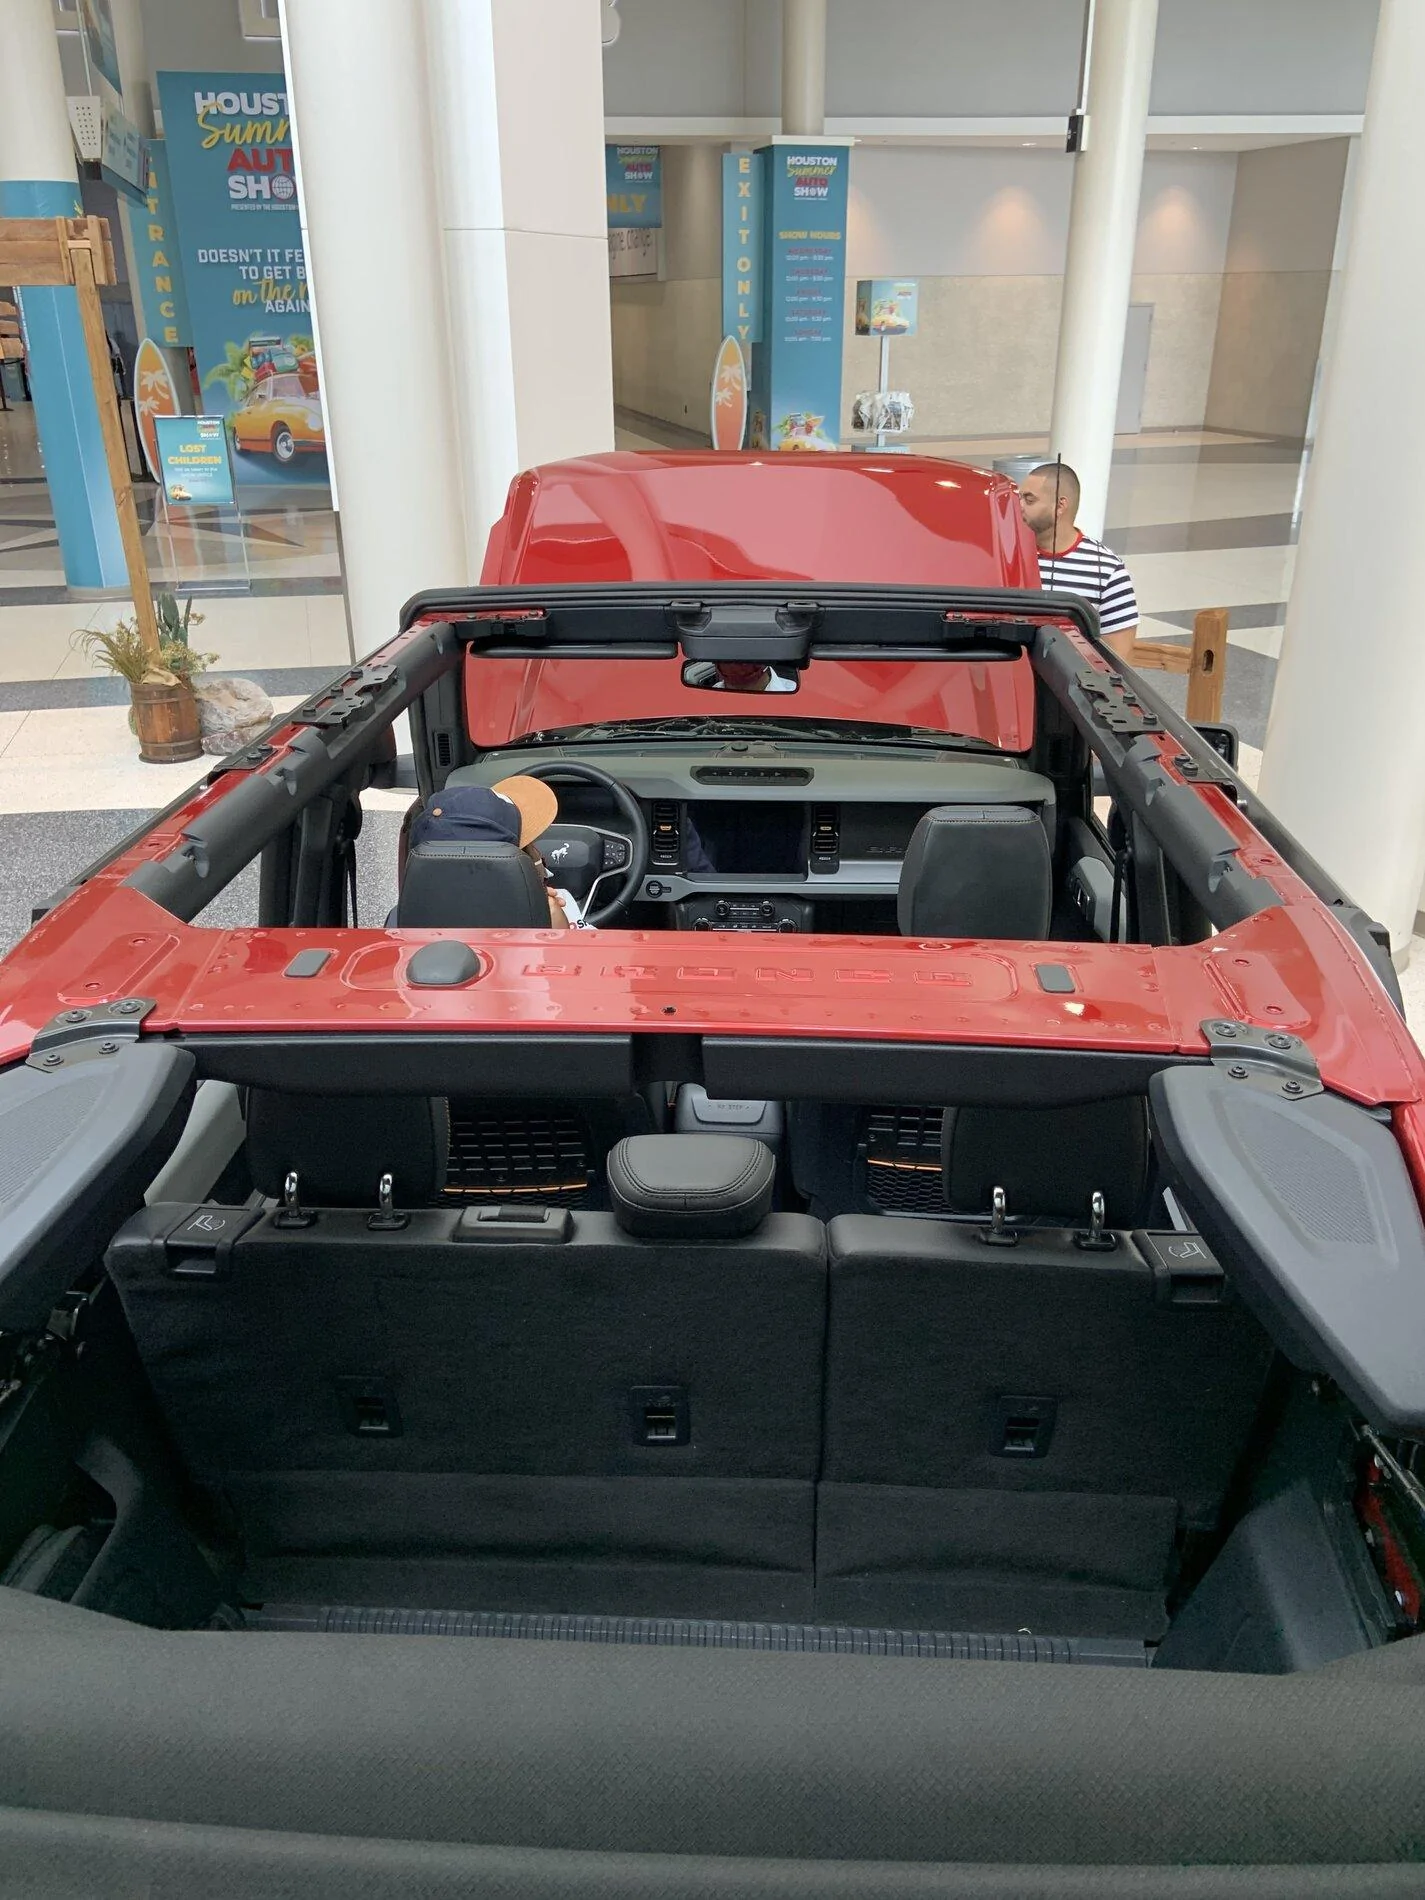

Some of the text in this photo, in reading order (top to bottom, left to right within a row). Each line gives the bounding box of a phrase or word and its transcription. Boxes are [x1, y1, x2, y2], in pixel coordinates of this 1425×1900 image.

[194, 91, 290, 116] HOUST
[197, 102, 290, 149] Sum
[617, 146, 658, 155] HOUSTON
[227, 147, 294, 172] AUT
[787, 156, 837, 166] HOUSTON
[624, 171, 653, 180] SHOW
[796, 177, 827, 187] AUTO
[228, 174, 297, 200] SHO
[794, 186, 828, 197] SHOW
[607, 193, 647, 213] NLY
[779, 231, 841, 240] SHOW HOURS
[147, 147, 179, 343] NTRANCE
[736, 158, 751, 340] EXIT ONLY
[198, 249, 304, 263] DOESN'T IT FE
[239, 265, 259, 280] TO
[263, 265, 291, 280] GET
[232, 289, 258, 306] on
[179, 444, 207, 453] LOST
[168, 456, 222, 465] CHILDREN
